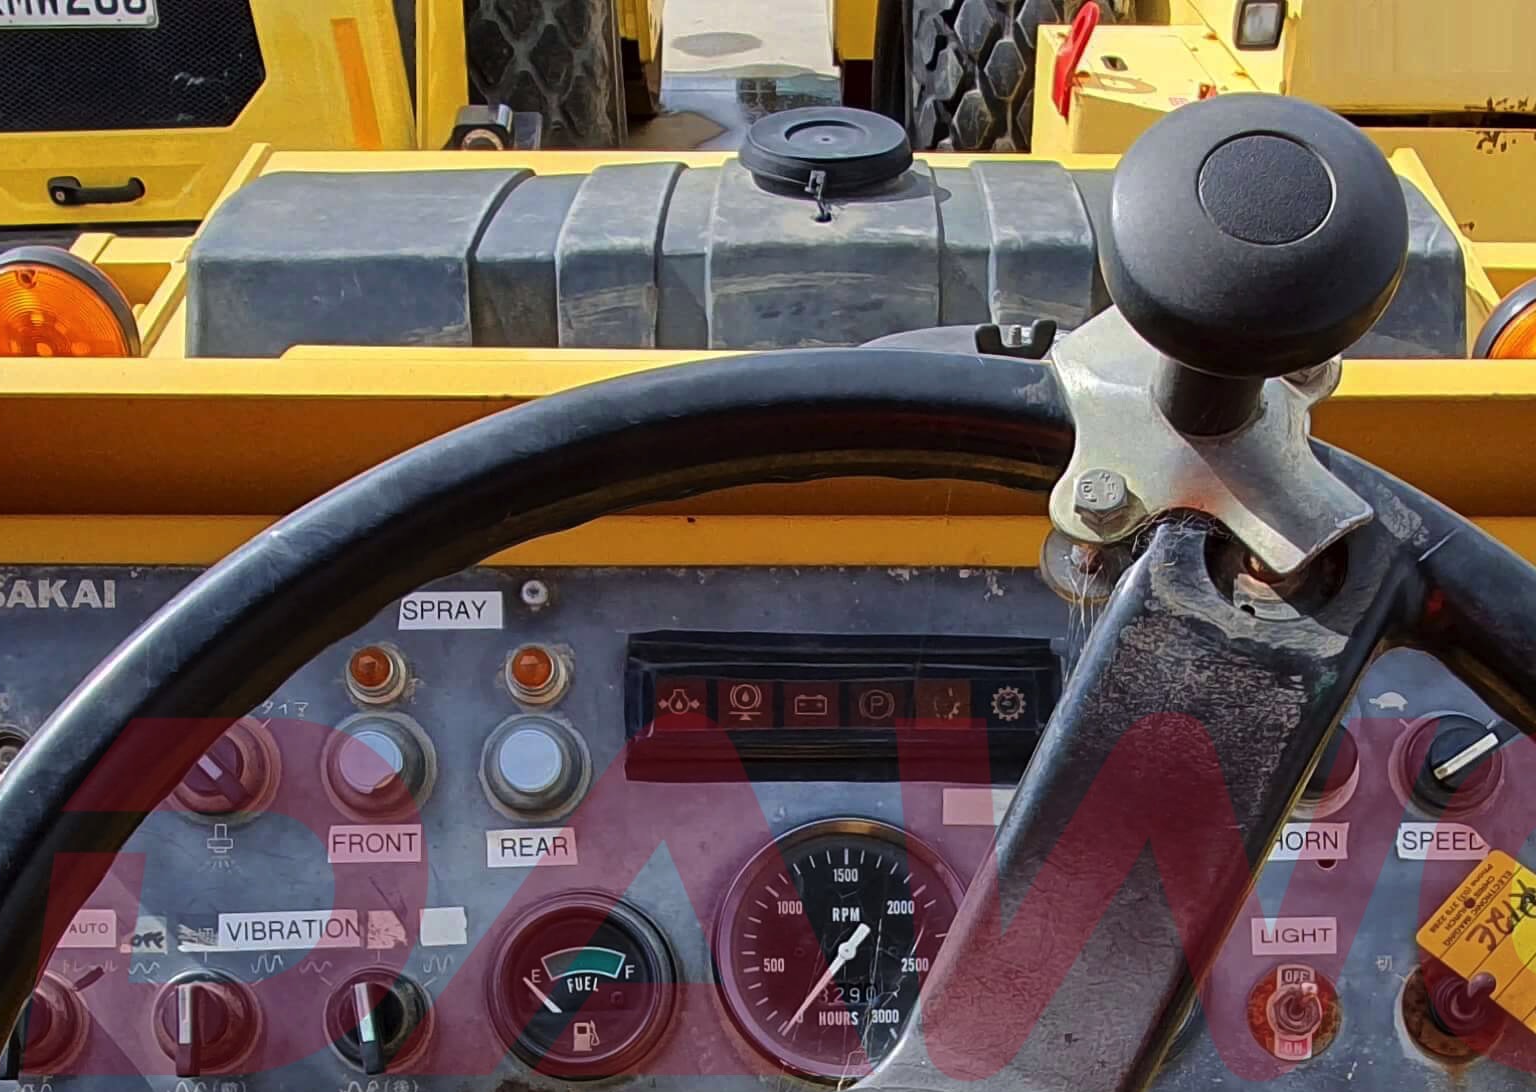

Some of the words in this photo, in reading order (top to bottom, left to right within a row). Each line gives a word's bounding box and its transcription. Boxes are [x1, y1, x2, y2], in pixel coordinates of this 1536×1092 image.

[401, 599, 487, 622] SPRAY
[332, 832, 419, 855] FRONT
[499, 836, 569, 858] REAR
[833, 868, 859, 883] 1500
[777, 901, 803, 915] 1000
[832, 907, 861, 922] RPM
[887, 901, 915, 915] 2000
[68, 922, 110, 936] AUTO
[224, 918, 361, 943] VIBRATION
[1260, 927, 1333, 944] LIGHT
[624, 964, 636, 980] F
[763, 957, 785, 972] 500
[901, 957, 930, 972] 2500
[531, 968, 542, 983] E
[567, 975, 600, 994] FUEL
[818, 1011, 860, 1026] HOURS
[871, 1009, 900, 1024] 3000
